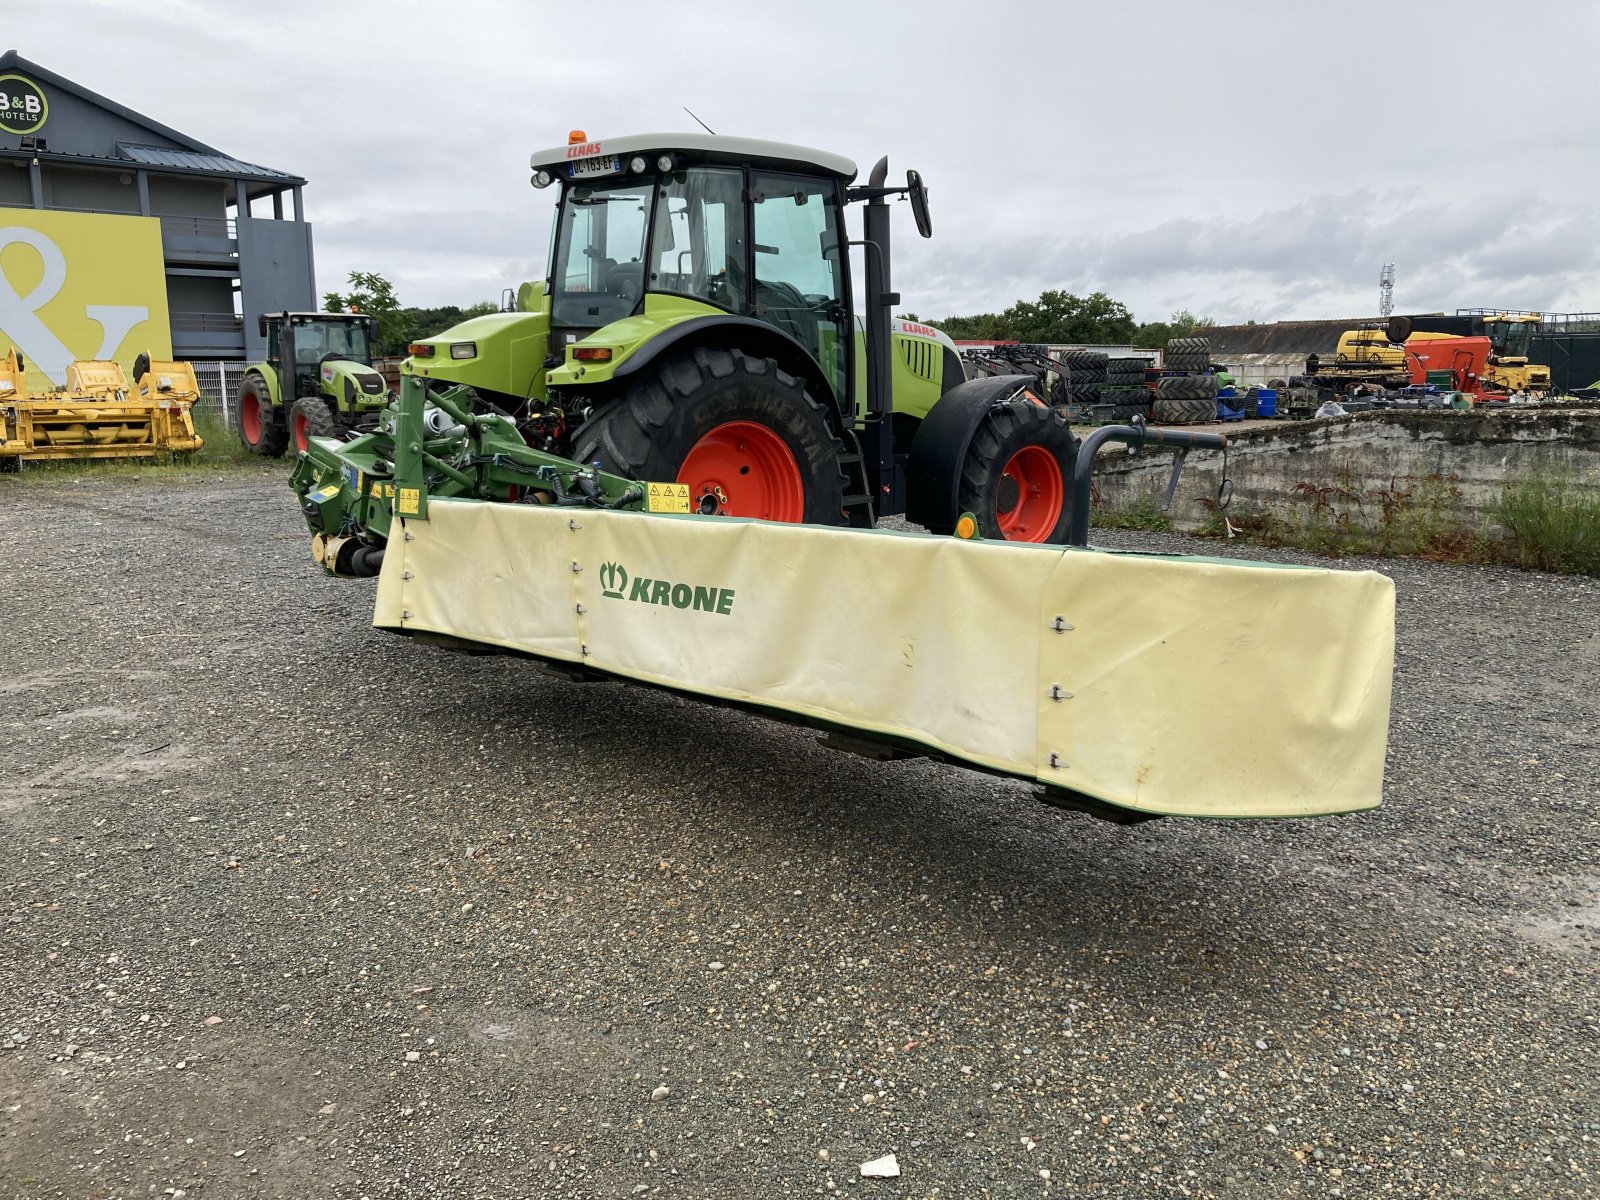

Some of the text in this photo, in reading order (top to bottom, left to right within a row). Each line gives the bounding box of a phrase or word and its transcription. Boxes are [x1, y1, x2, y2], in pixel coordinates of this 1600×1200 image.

[567, 143, 602, 158] CLAAS
[902, 322, 936, 337] CLAAS
[629, 577, 735, 615] KRONE
